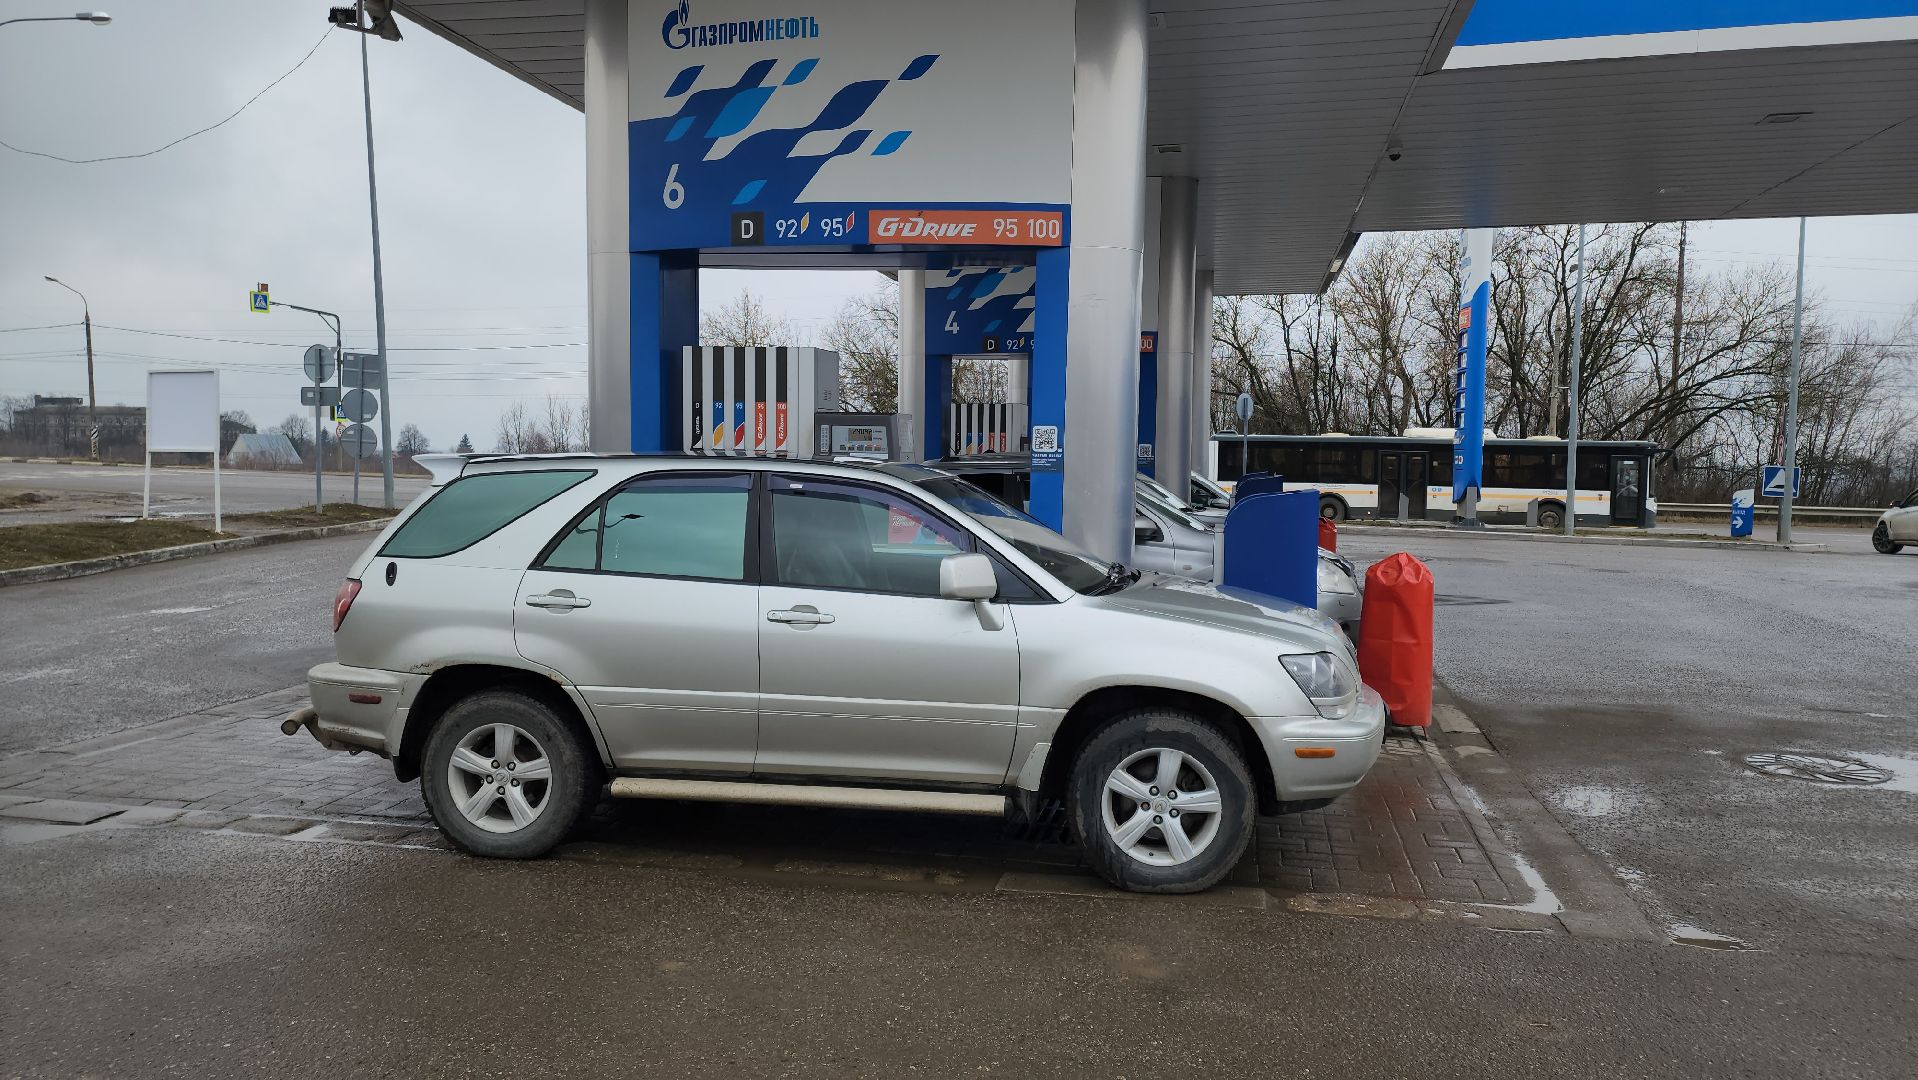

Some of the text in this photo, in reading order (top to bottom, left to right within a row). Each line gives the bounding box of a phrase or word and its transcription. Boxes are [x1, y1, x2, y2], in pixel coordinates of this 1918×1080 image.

[691, 16, 820, 48] ГАЗПРОМНЕФТЬ
[662, 163, 685, 210] 6
[741, 217, 844, 239] D 92 95
[992, 218, 1019, 238] 95
[1026, 217, 1060, 239] 100
[944, 310, 960, 335] 4
[987, 339, 995, 351] D
[1006, 339, 1019, 351] 92
[777, 402, 787, 410] 100
